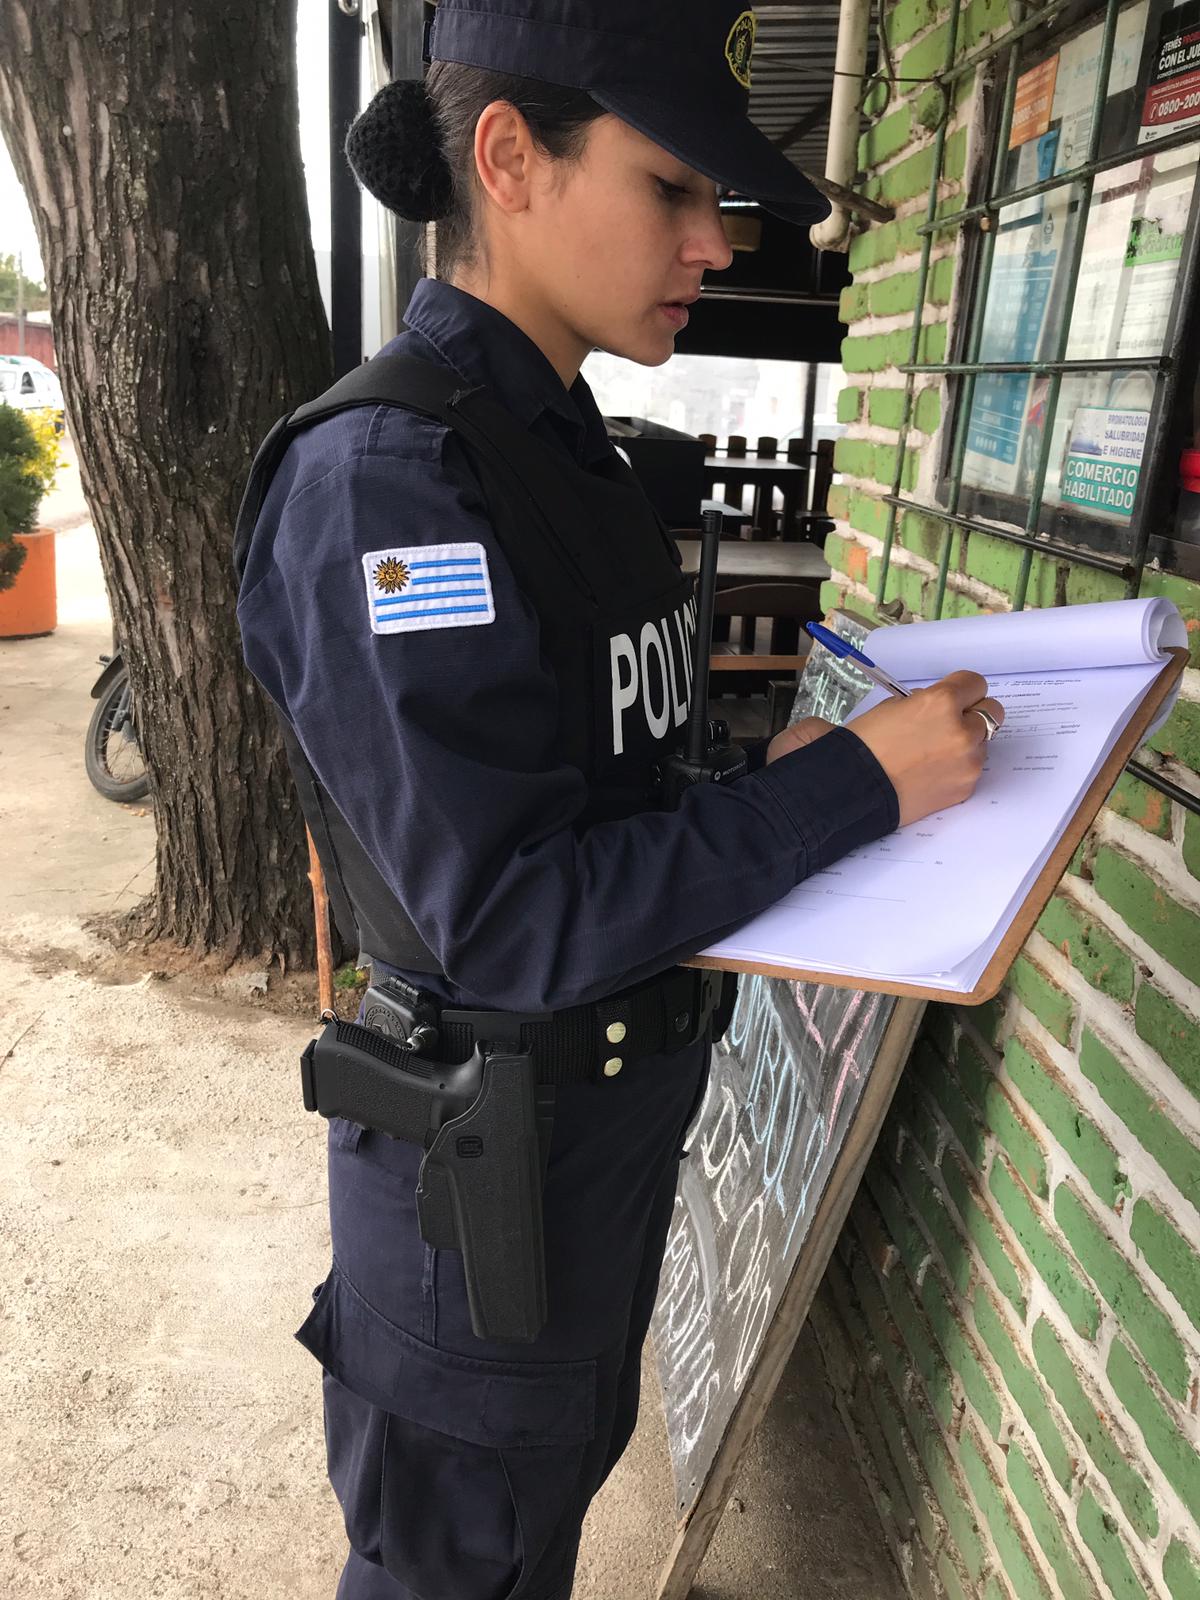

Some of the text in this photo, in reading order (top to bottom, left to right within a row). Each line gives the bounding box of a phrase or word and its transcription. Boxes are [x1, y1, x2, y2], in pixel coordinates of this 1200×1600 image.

[1159, 52, 1177, 70] CON
[1177, 49, 1186, 64] EL
[1105, 430, 1145, 443] SALUBRIDAD
[1104, 445, 1142, 459] E HIGIENE
[1067, 460, 1137, 487] COMERCIO
[1063, 479, 1133, 509] HABILITADO
